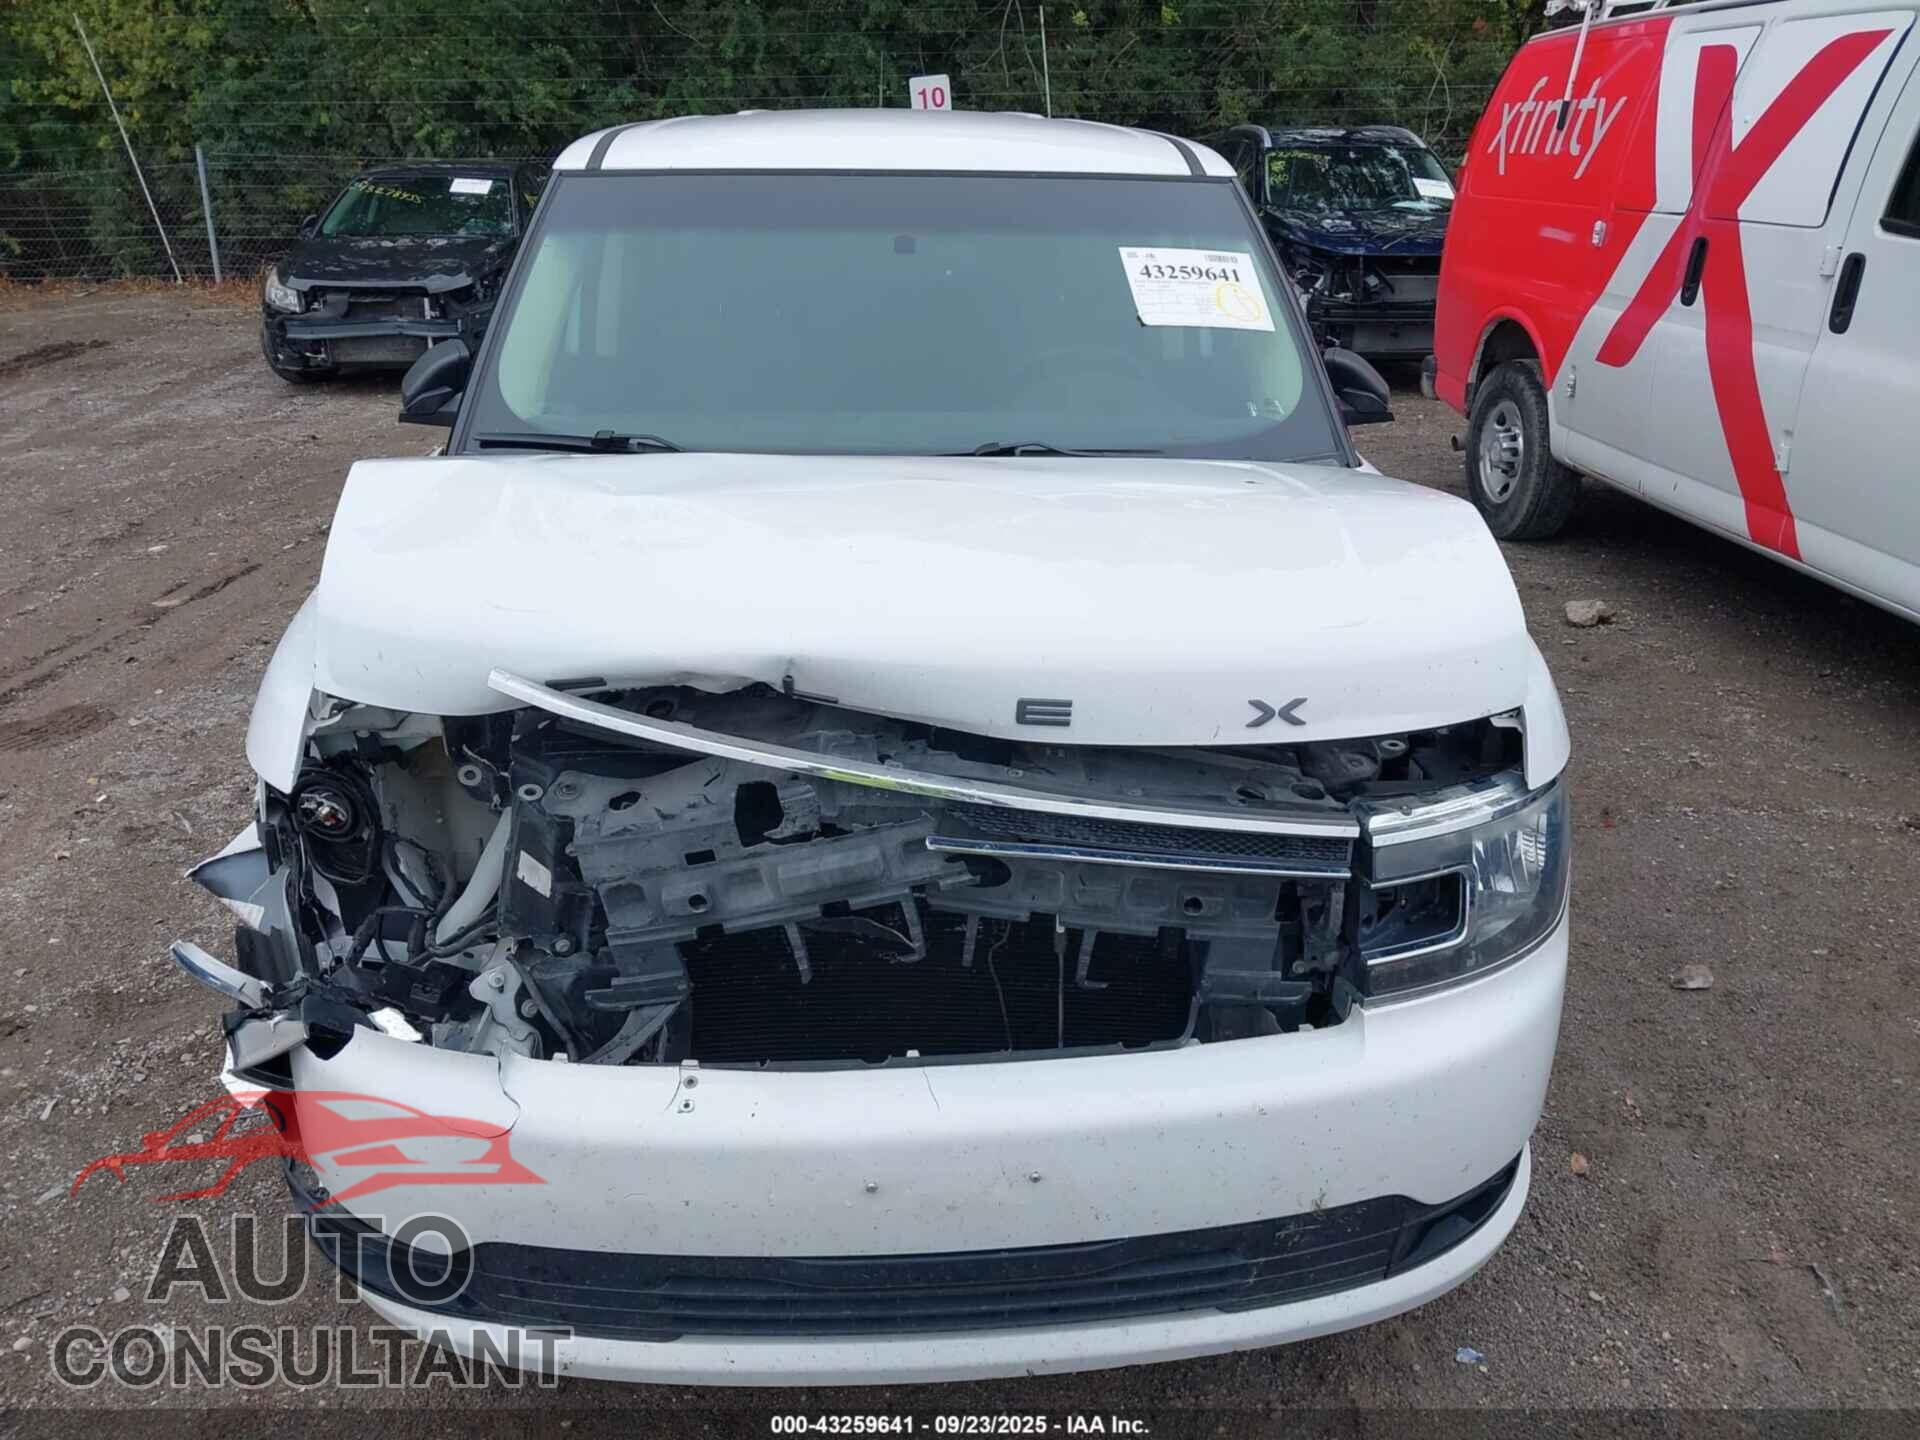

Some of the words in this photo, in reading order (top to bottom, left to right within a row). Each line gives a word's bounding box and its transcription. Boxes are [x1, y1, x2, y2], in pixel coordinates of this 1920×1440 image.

[917, 86, 946, 111] 10
[1487, 76, 1628, 180] xfinity
[1139, 264, 1240, 282] 43259641
